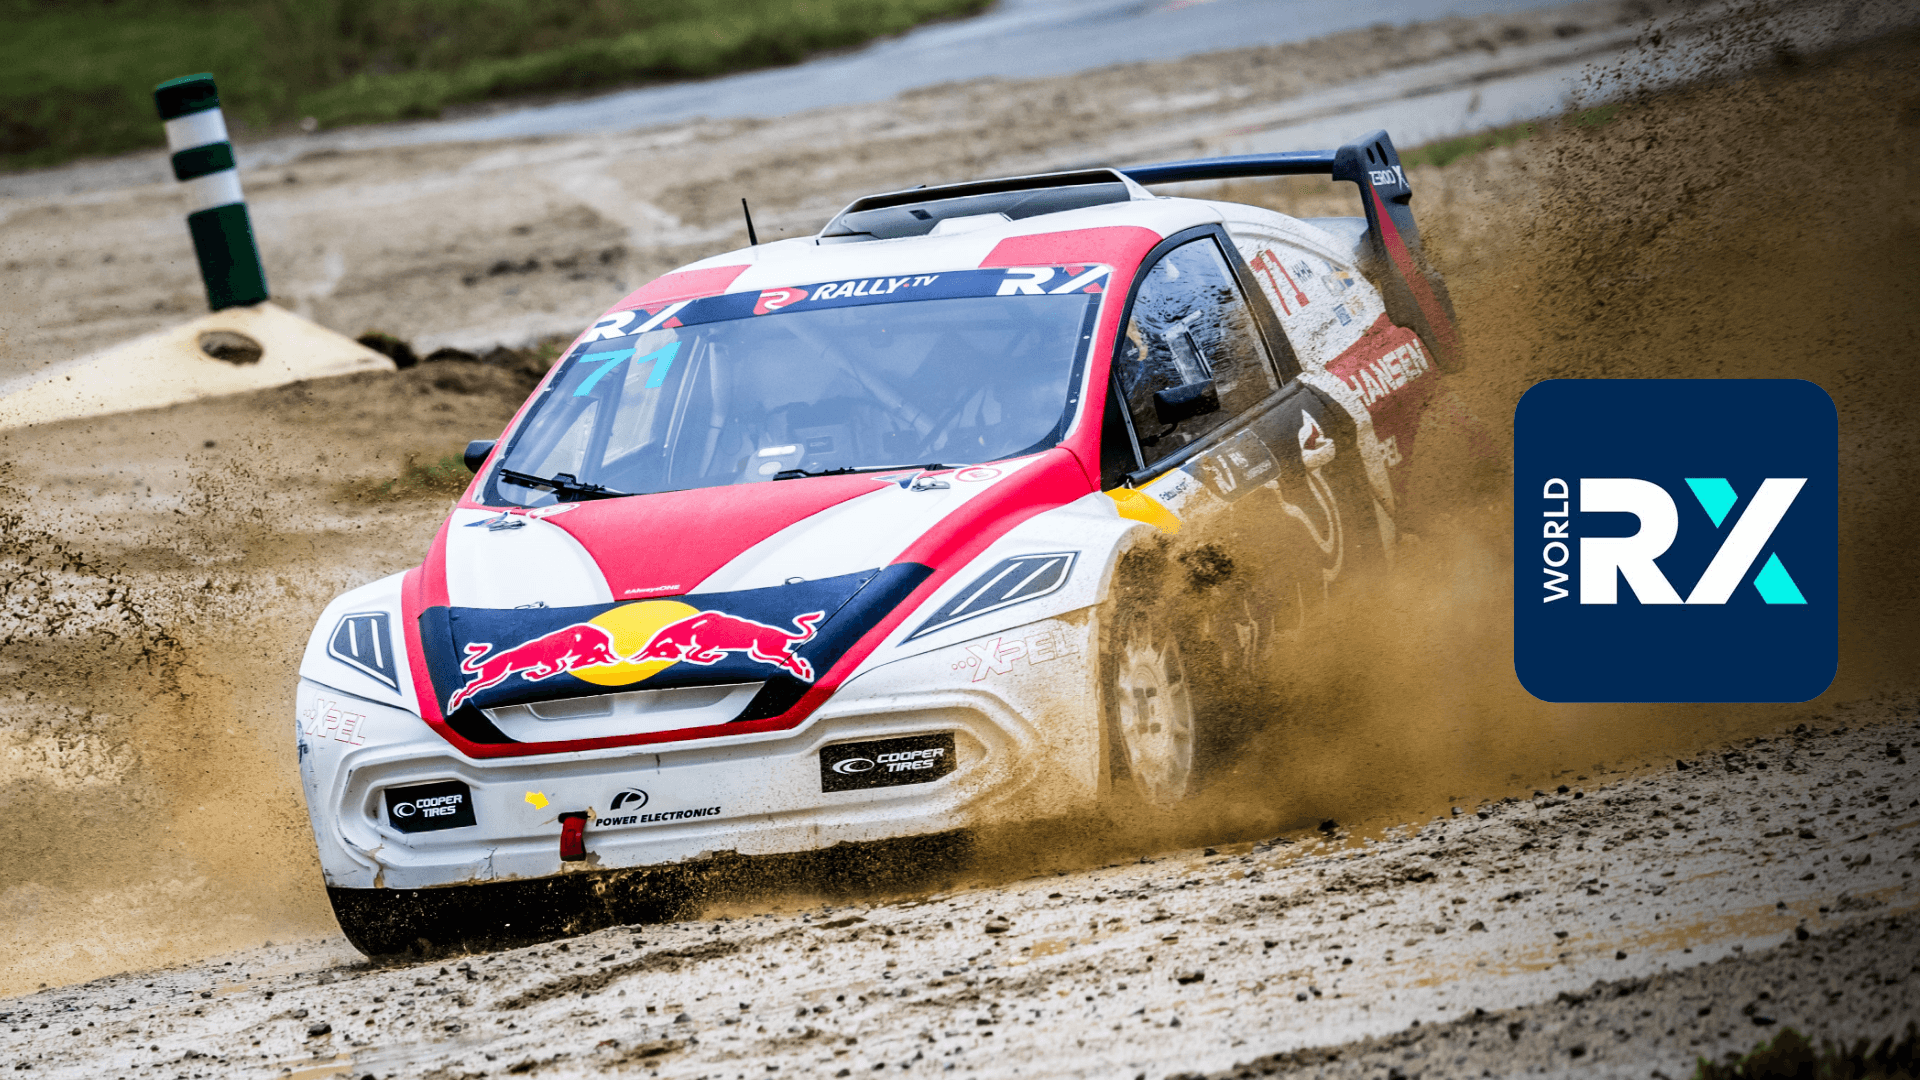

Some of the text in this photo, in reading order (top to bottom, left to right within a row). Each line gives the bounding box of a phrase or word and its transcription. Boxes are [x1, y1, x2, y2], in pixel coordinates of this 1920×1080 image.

[994, 265, 1111, 296] RX
[1250, 249, 1310, 317] 71
[580, 299, 693, 343] RX
[572, 341, 682, 397] 71
[1343, 338, 1429, 407] HANSEN
[305, 698, 366, 746] XPEL
[876, 747, 945, 764] COOPER
[886, 759, 934, 773] TIRES
[416, 794, 463, 809] COOPER
[422, 805, 456, 818] TIRES
[595, 806, 721, 827] POWER ELECTRONICS
